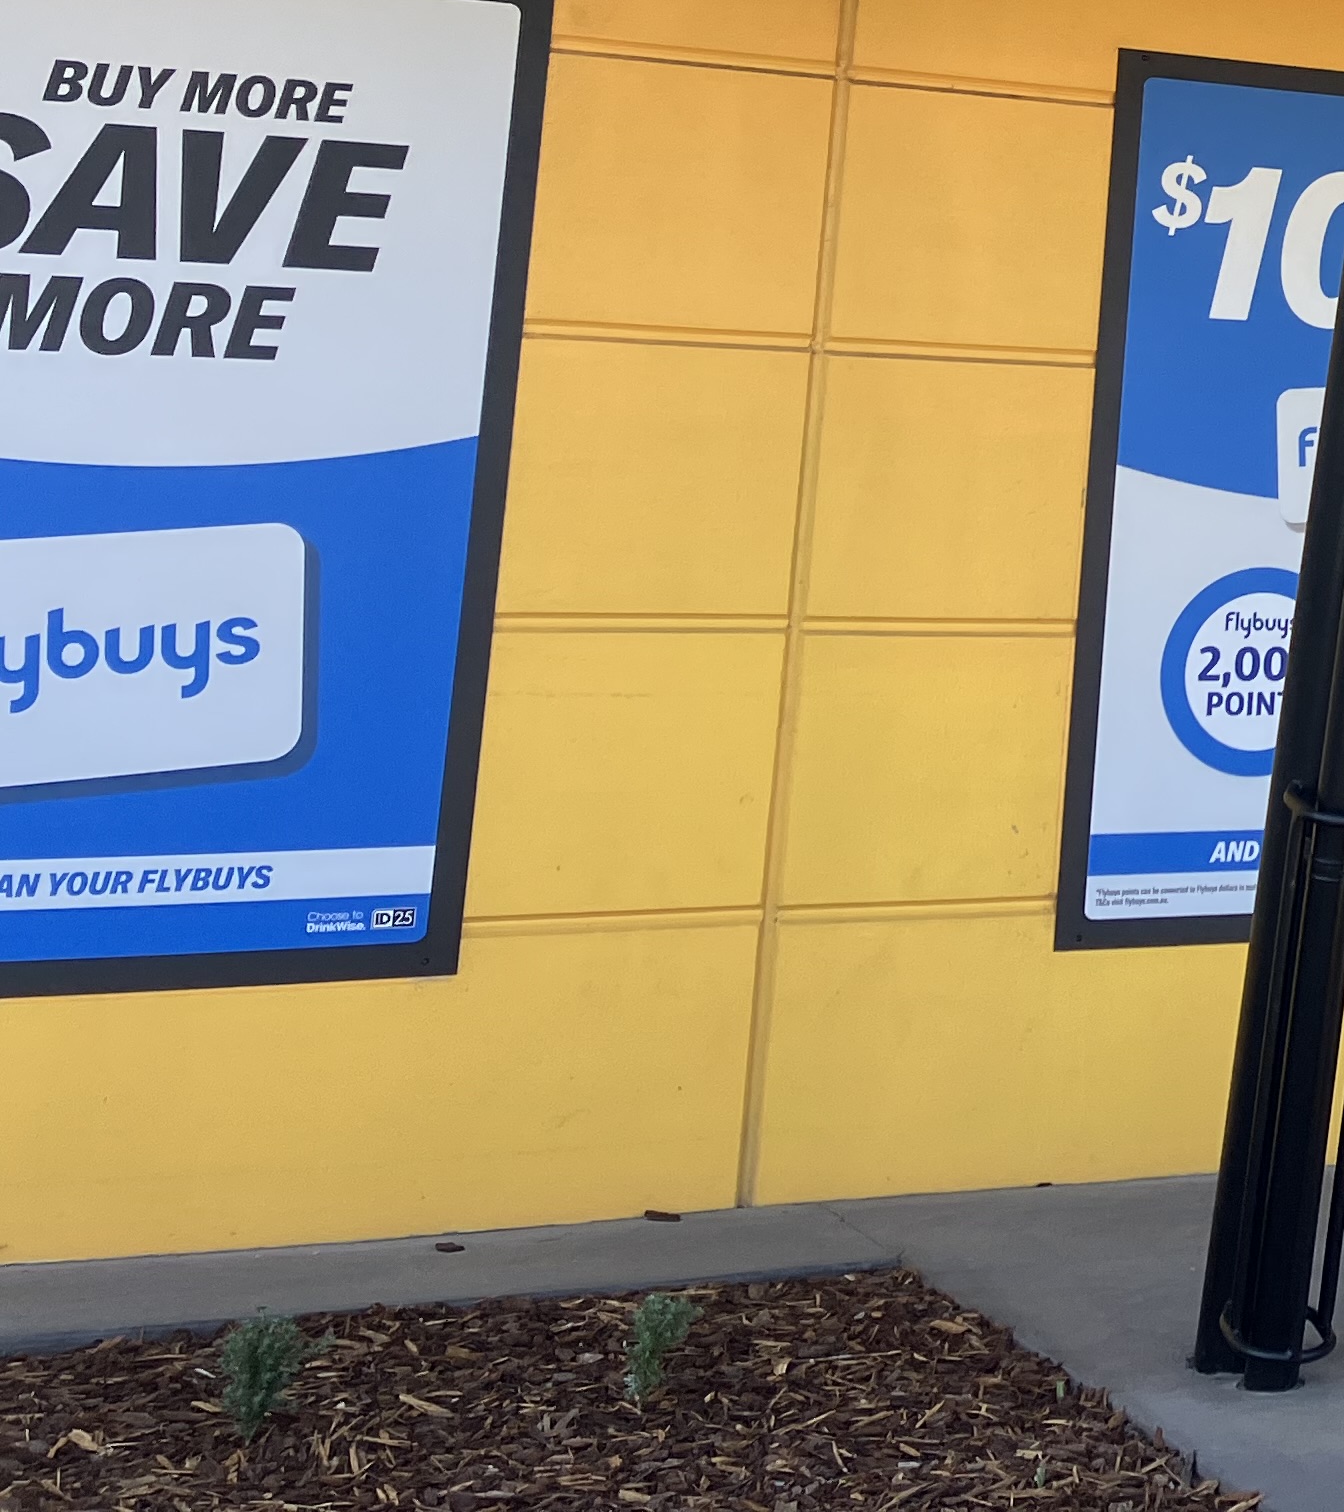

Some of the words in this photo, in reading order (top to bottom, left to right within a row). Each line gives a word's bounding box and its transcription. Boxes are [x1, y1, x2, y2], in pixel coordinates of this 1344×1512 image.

[43, 59, 176, 109] BUY
[181, 70, 353, 123] MORE
[1198, 646, 1289, 688] 2,00
[1206, 691, 1284, 717] POIN
[1209, 840, 1261, 864] AND
[49, 870, 133, 897] YOUR
[137, 864, 274, 894] FLYBUYS
[307, 911, 350, 922] Choose
[352, 910, 364, 919] to
